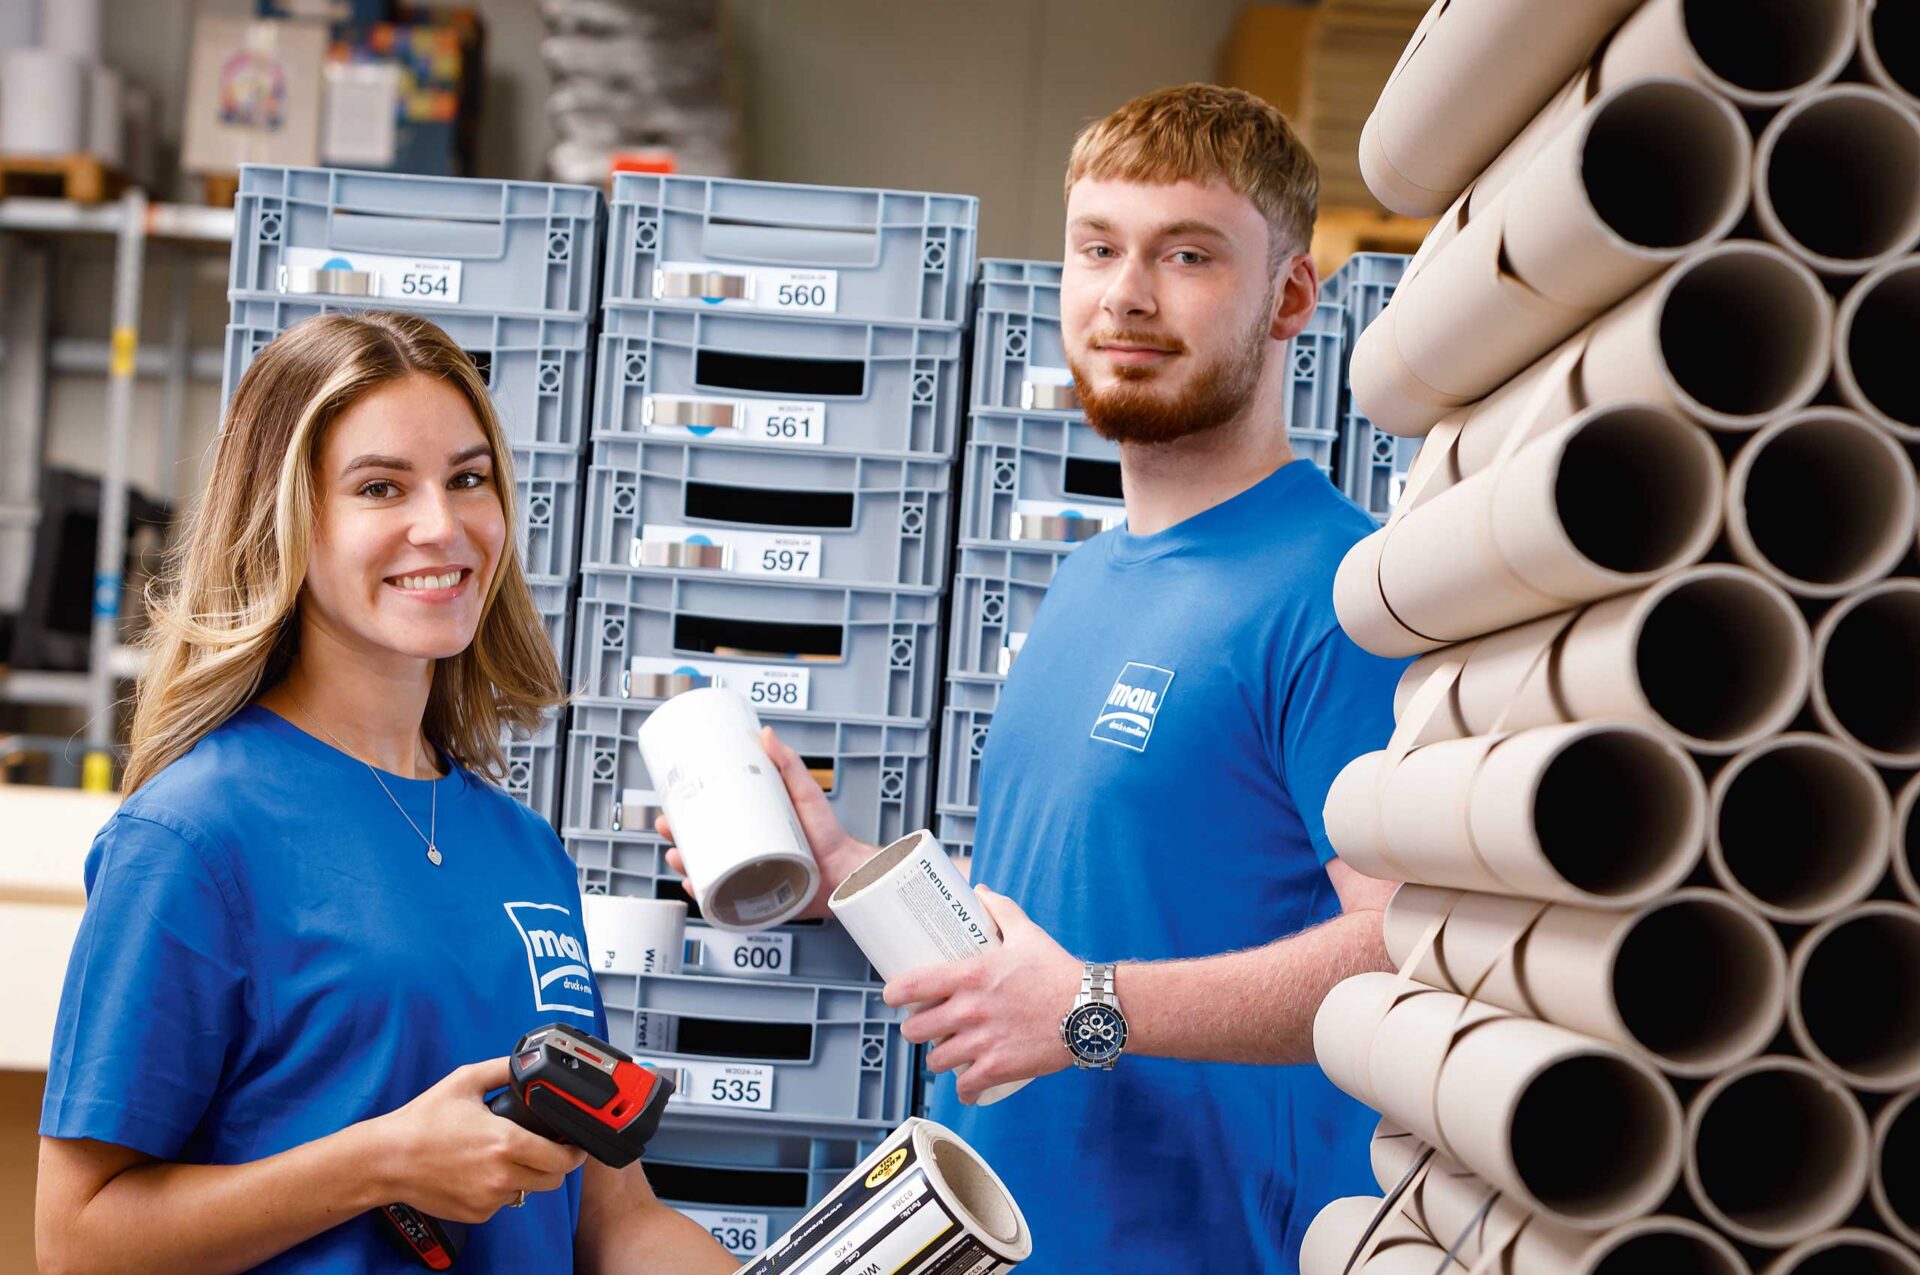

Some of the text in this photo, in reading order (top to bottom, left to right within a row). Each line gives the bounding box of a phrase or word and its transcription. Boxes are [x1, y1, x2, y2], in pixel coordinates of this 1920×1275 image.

[402, 273, 448, 296] 554
[778, 285, 825, 306] 560
[766, 416, 809, 438] 561
[762, 550, 809, 572] 597
[751, 682, 797, 704] 598
[920, 858, 988, 945] rhenus ZW 977
[734, 946, 782, 970] 600
[725, 1067, 762, 1076] W2024-34
[711, 1079, 761, 1102] 535
[871, 1154, 901, 1182] KROON
[880, 1156, 893, 1169] OIL
[711, 1227, 757, 1251] 536
[834, 1240, 853, 1258] 5 KG
